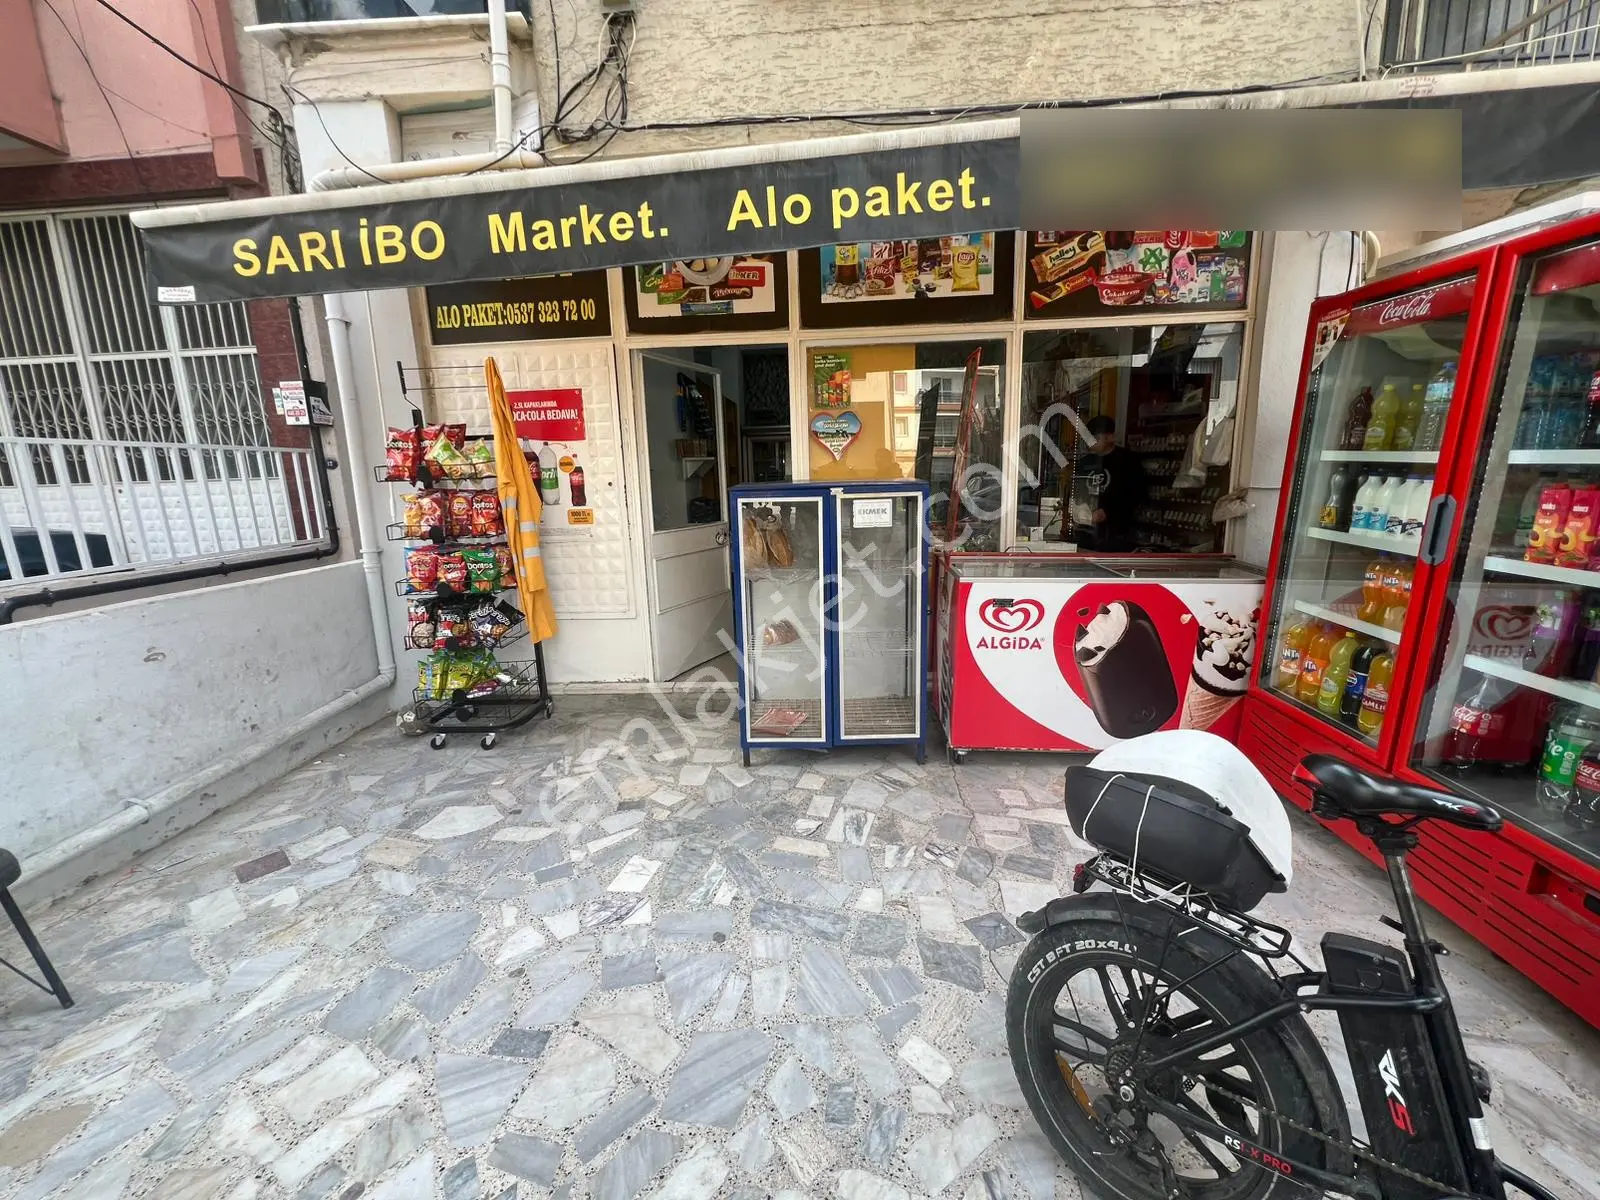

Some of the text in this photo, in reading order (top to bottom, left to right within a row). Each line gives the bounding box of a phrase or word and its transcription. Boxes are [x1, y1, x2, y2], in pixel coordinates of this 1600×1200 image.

[232, 167, 993, 278] SARI İBO Market. Alo paket.
[436, 304, 460, 329] ALO
[538, 300, 560, 323] 323
[562, 299, 578, 322] 72
[580, 298, 597, 321] 00
[546, 408, 579, 420] BEDAVA!
[1026, 957, 1047, 984] CST
[1262, 1153, 1293, 1175] PRO
